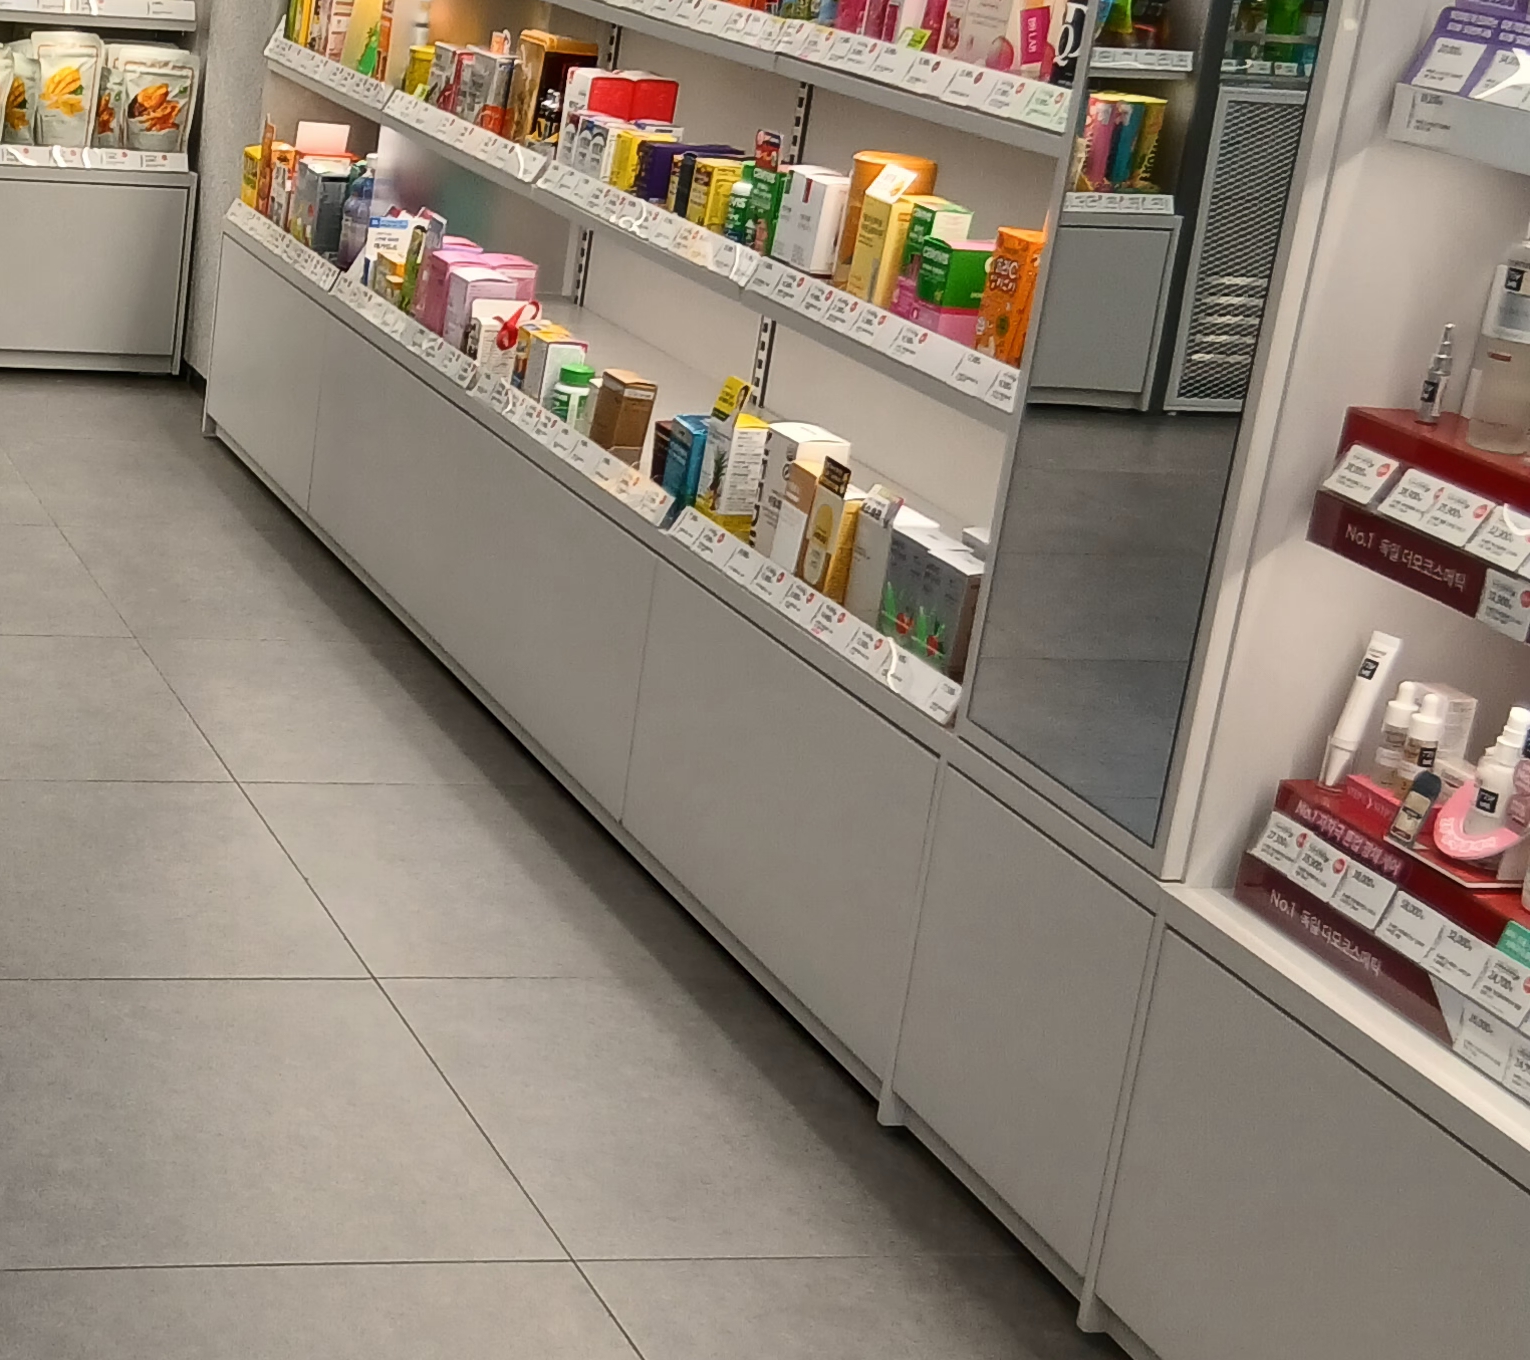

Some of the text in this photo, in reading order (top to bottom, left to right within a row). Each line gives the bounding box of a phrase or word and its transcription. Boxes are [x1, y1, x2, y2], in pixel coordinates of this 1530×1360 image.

[1344, 522, 1467, 592] No.1 독일 더모코스메틱
[1270, 888, 1384, 977] No.1 독일 더모코스메틱
